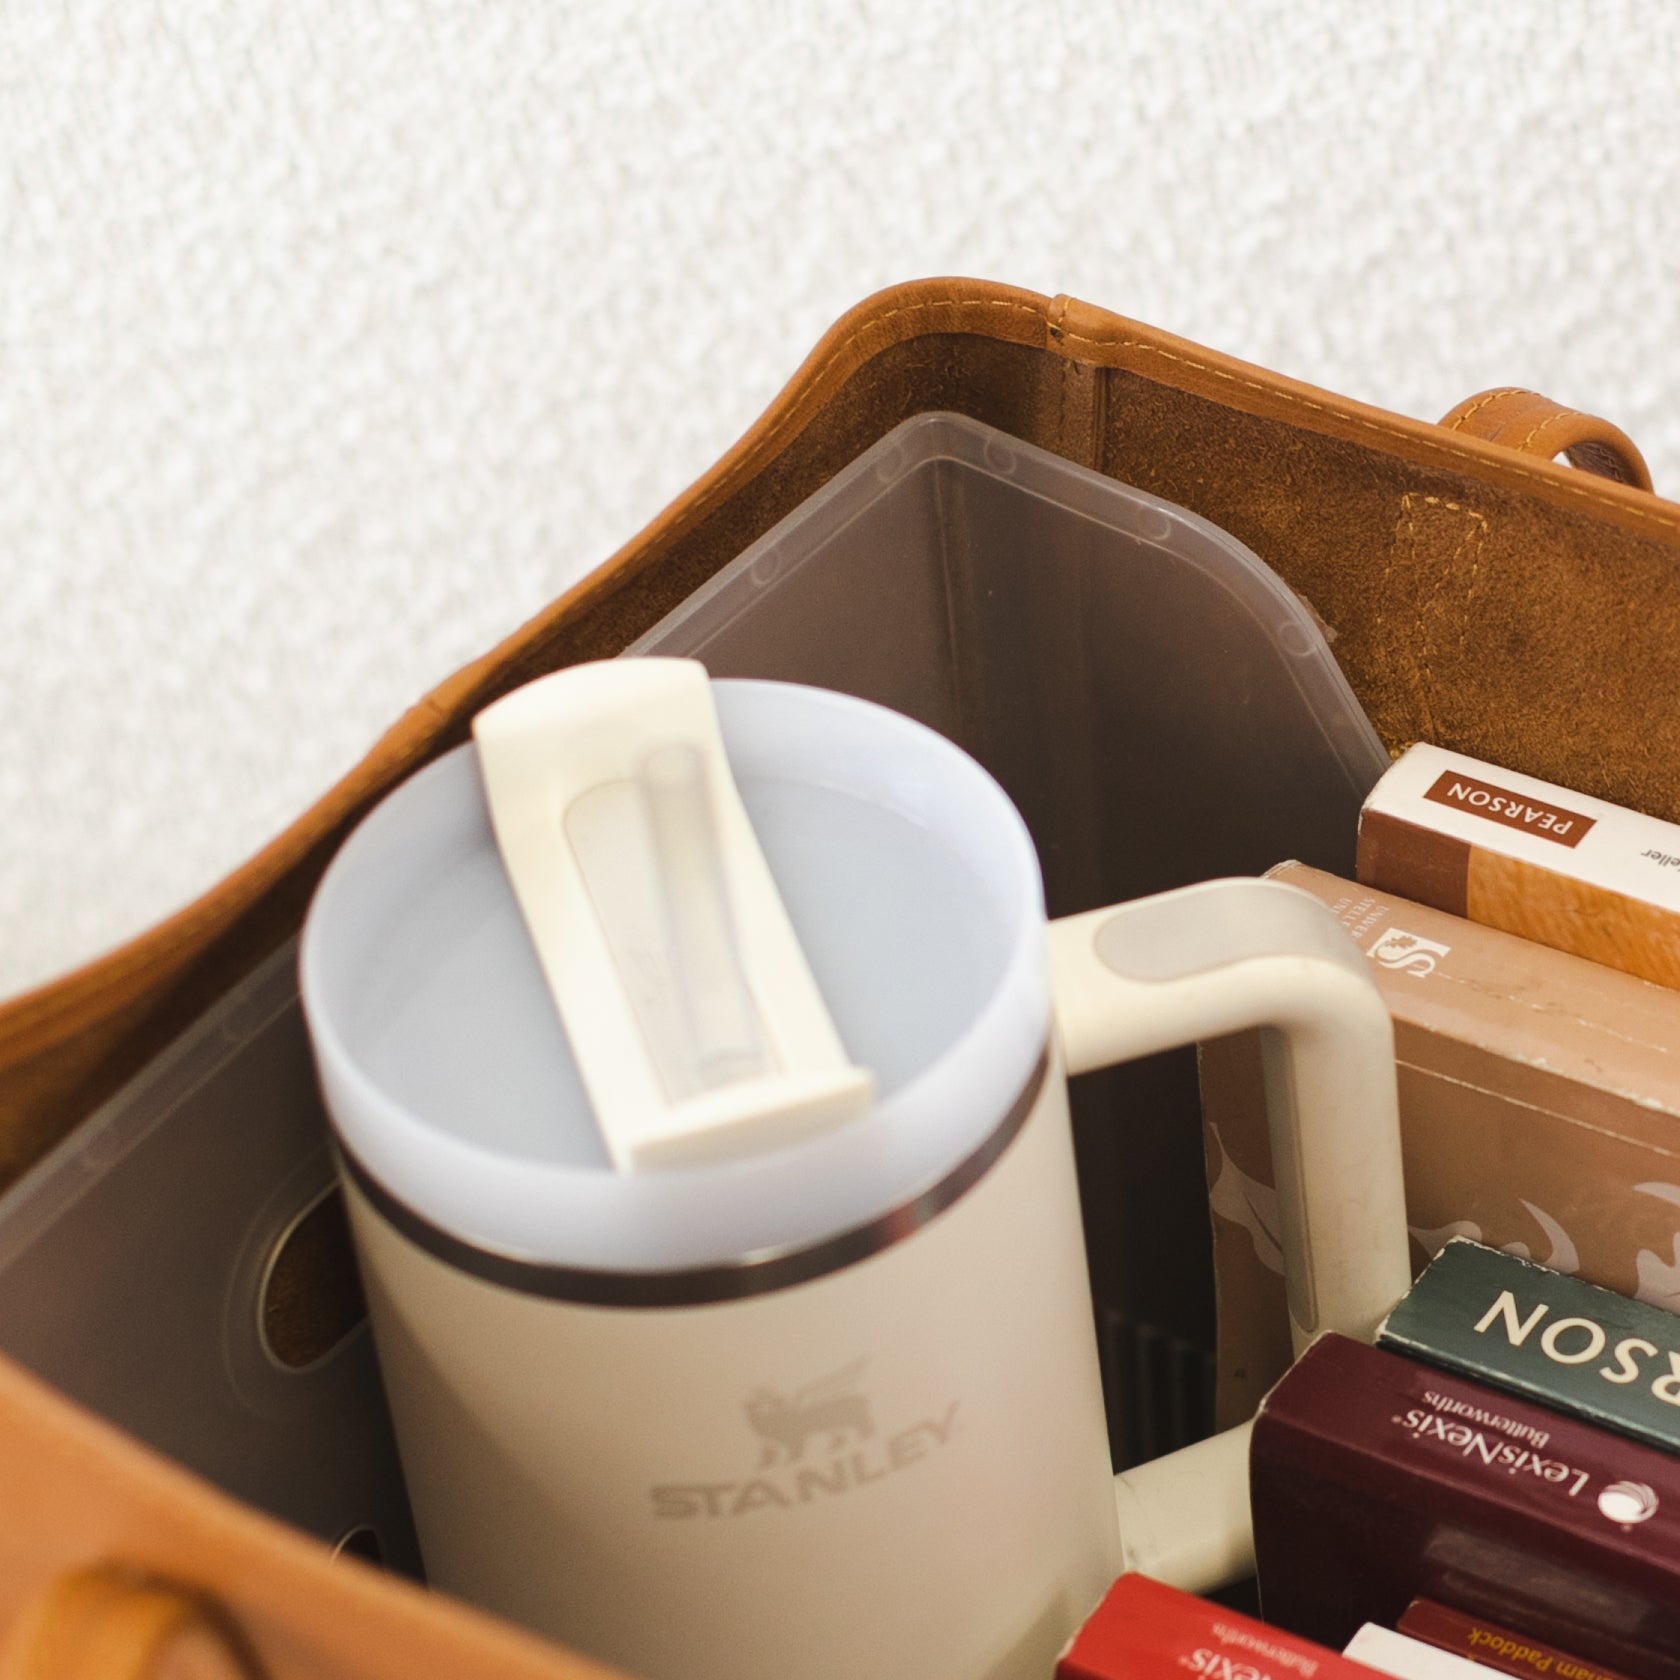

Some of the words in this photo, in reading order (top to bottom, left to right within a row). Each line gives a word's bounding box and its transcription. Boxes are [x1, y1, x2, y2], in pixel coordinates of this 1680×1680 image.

[1447, 780, 1575, 837] PEARSON
[1423, 1389, 1551, 1450] Butterworths
[650, 1400, 960, 1521] STANLEY
[1402, 1407, 1591, 1498] LexisNexis
[1465, 1626, 1555, 1676] Paddock
